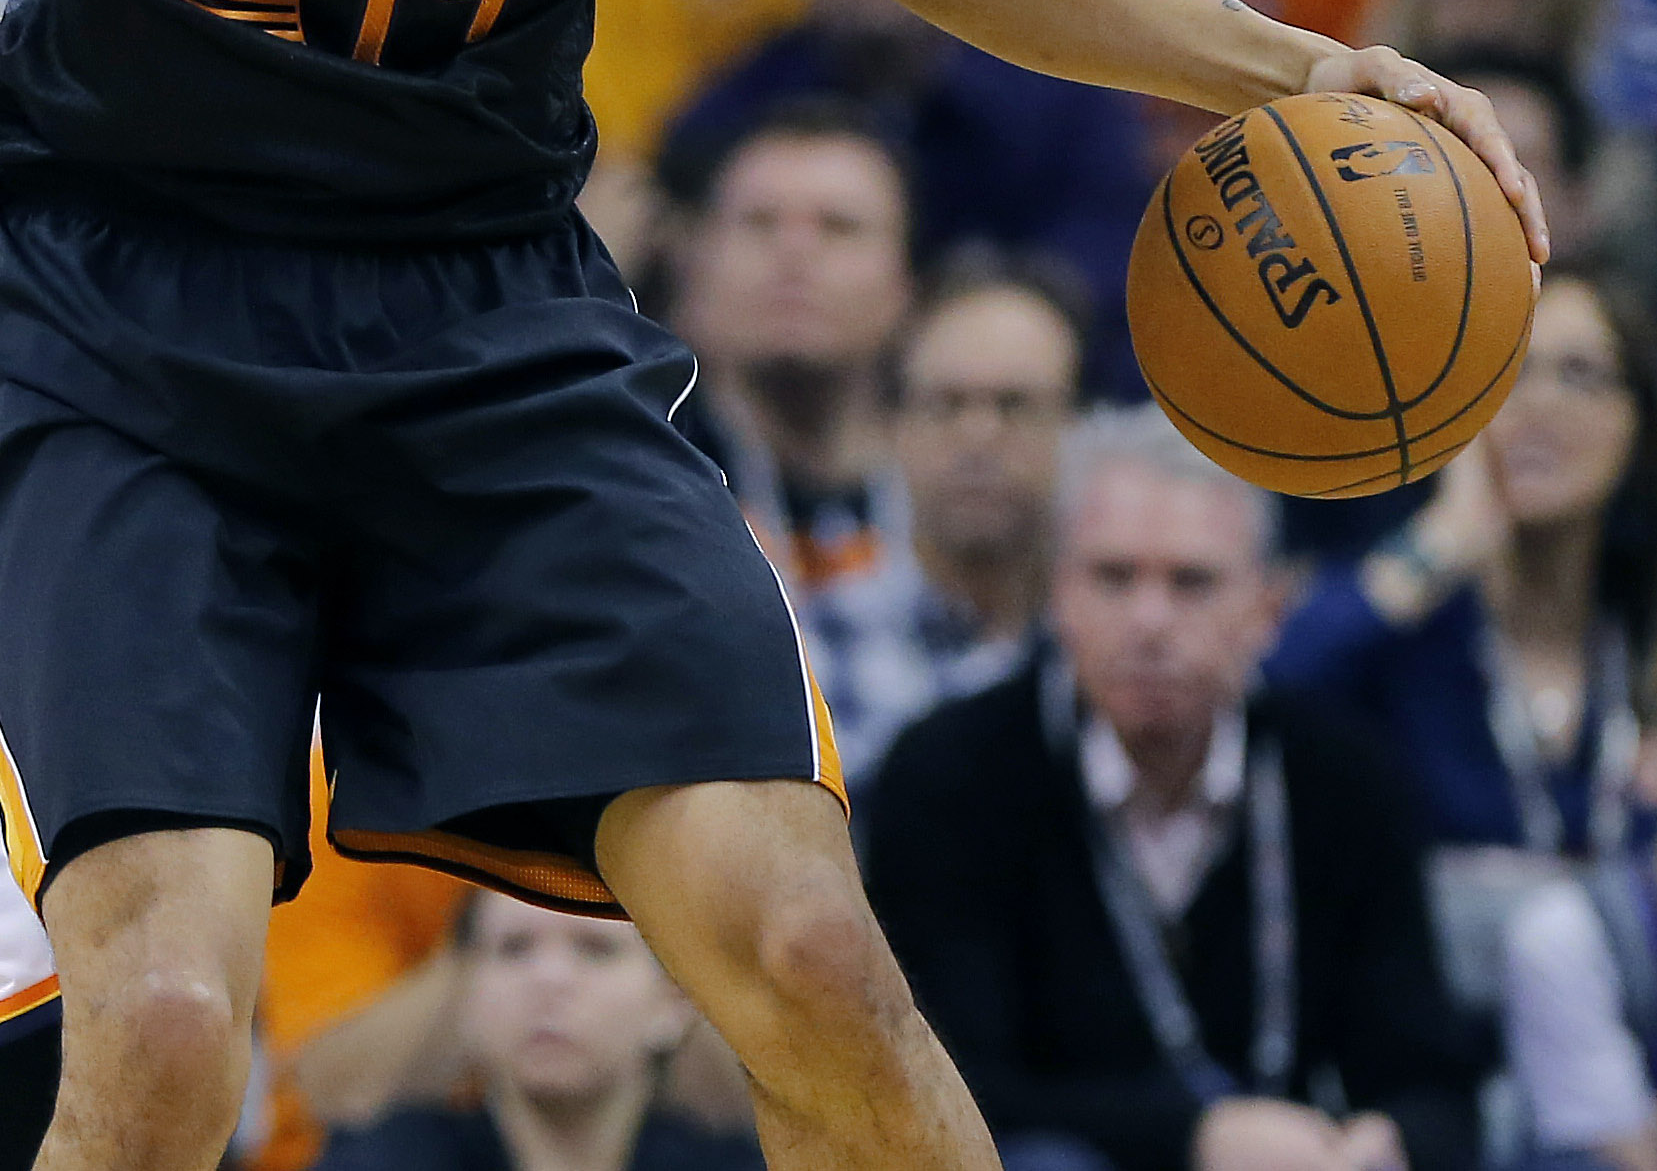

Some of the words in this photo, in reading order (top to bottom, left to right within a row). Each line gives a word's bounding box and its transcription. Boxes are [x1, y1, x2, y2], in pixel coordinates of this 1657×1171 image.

[1394, 188, 1413, 208] BALL
[1194, 116, 1341, 329] SPALDING
[1401, 213, 1418, 237] GAME
[1410, 242, 1428, 282] OFFICIAL
